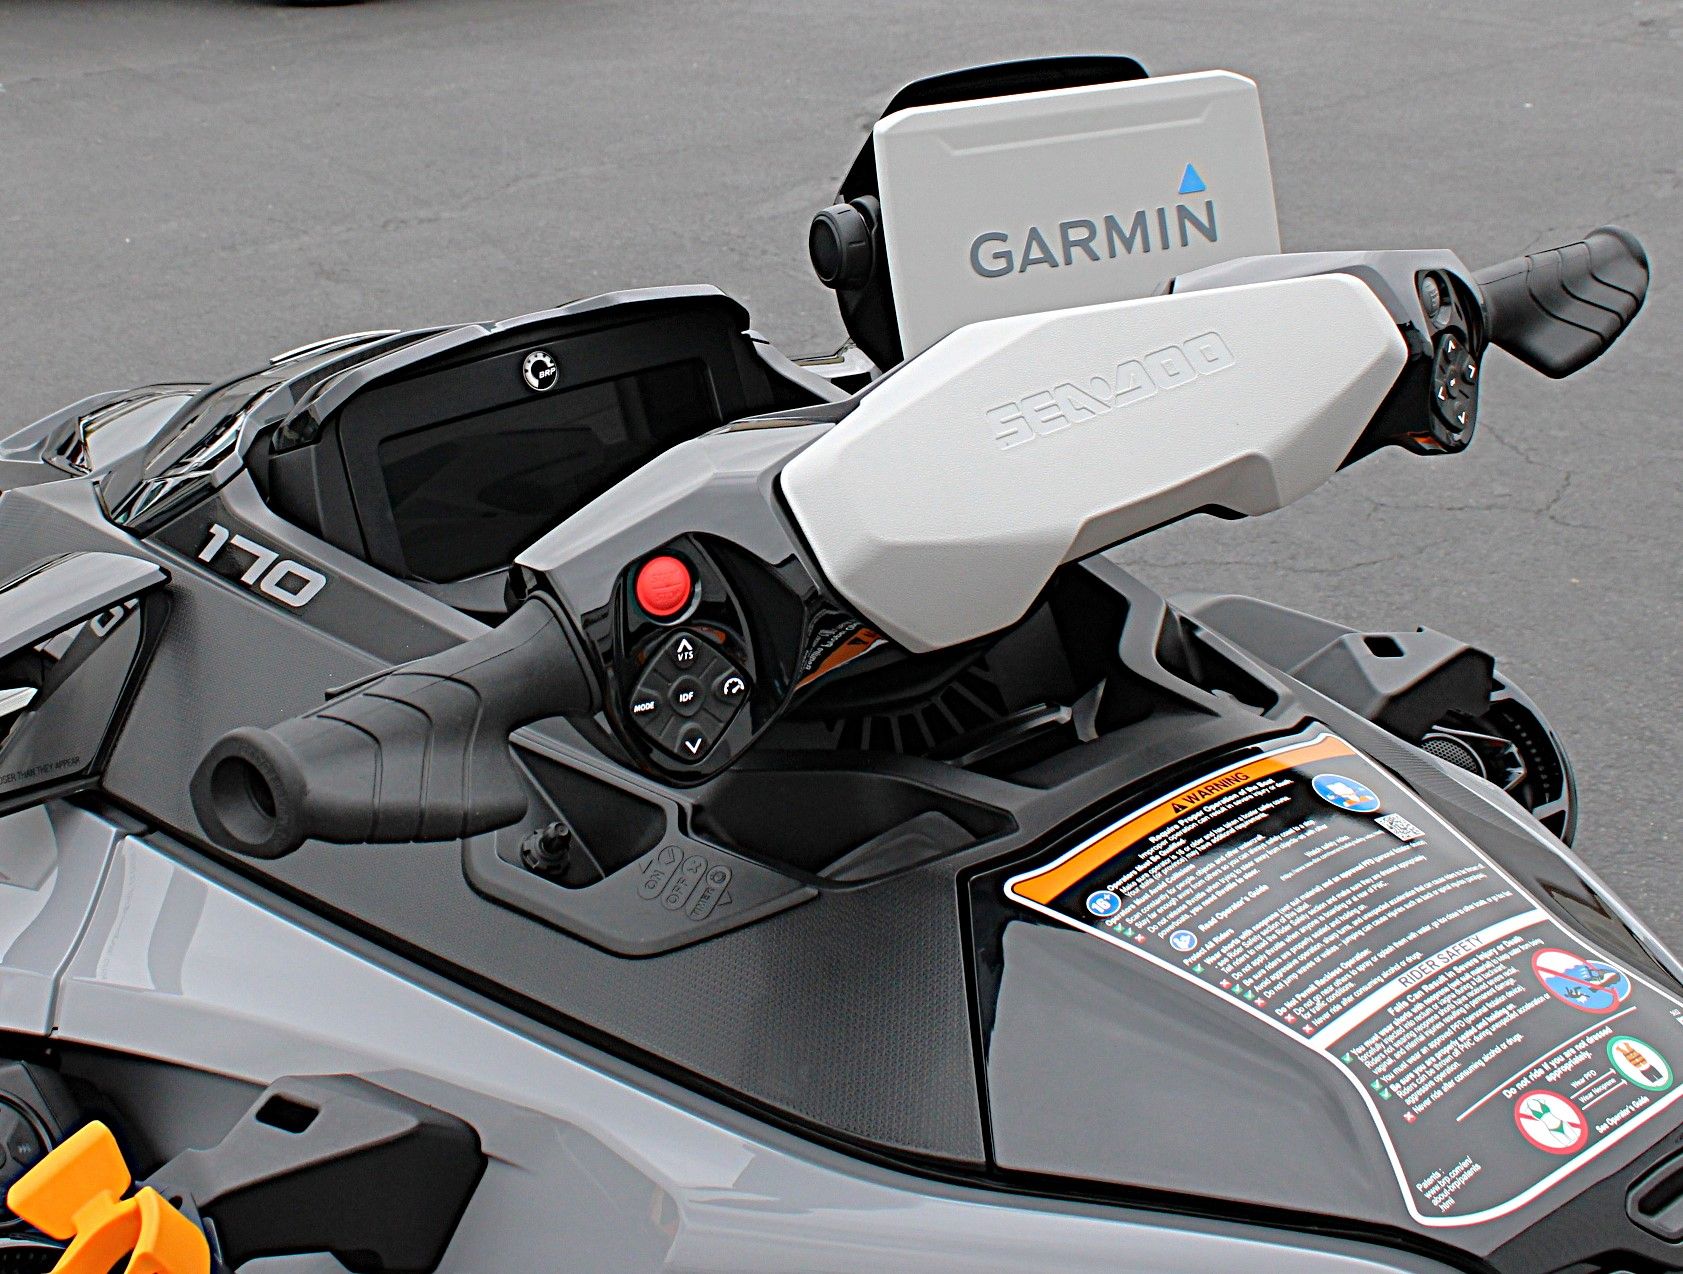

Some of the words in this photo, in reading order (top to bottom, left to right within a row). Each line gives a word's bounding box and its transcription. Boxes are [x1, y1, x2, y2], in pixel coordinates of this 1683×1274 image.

[970, 200, 1217, 278] GARMIN
[539, 367, 556, 379] BRP
[198, 523, 327, 607] 170
[678, 651, 694, 662] VTS
[633, 701, 655, 713] MODE
[679, 691, 694, 703] IDF
[17, 768, 35, 780] THAN
[36, 763, 54, 775] THEY
[54, 756, 80, 769] APPEAR
[1182, 772, 1250, 805] WARNING
[1148, 824, 1182, 843] Require
[1177, 810, 1206, 826] Proper
[1201, 794, 1239, 812] Operation
[1255, 778, 1276, 787] Boat
[644, 868, 665, 890] ON
[666, 877, 687, 905] OFF
[1104, 905, 1135, 927] Operators
[1133, 893, 1151, 906] Must
[1148, 881, 1168, 895] Avoid
[1164, 864, 1196, 884] Collisions
[1106, 870, 1138, 891] Operators
[1134, 859, 1152, 872] Must
[689, 886, 716, 917] TIMER
[1156, 914, 1191, 938] powerboats,
[1189, 905, 1203, 915] you
[1201, 894, 1218, 906] need
[1214, 882, 1238, 897] throttle
[1243, 869, 1261, 880] steer.
[1198, 917, 1217, 931] Read
[1214, 897, 1251, 920] Operator's
[1248, 885, 1269, 898] Guide
[1183, 947, 1207, 965] Protect
[1205, 941, 1215, 950] All
[1213, 929, 1234, 944] Riders
[1232, 972, 1242, 980] Do
[1242, 964, 1252, 973] not
[1251, 954, 1268, 966] apply
[1264, 941, 1285, 955] throttle
[1284, 931, 1300, 942] when
[1298, 919, 1320, 933] anyone
[1322, 902, 1349, 917] boarding
[1371, 881, 1389, 890] PWC.
[1242, 978, 1253, 986] Be
[1252, 969, 1265, 979] sure
[1264, 958, 1281, 970] riders
[1289, 937, 1314, 954] properly
[1311, 924, 1331, 938] seated
[1329, 918, 1342, 928] and
[1338, 909, 1362, 921] holding
[1387, 1001, 1409, 1015] Falls
[1406, 990, 1425, 1003] Can
[1421, 974, 1448, 993] Result
[1452, 958, 1480, 973] Severe
[1475, 948, 1501, 960] Injury
[1501, 935, 1524, 947] Death
[1397, 960, 1440, 987] RIDER
[1436, 935, 1485, 964] SAFETY
[1275, 1008, 1286, 1016] Do
[1284, 998, 1298, 1008] Not
[1295, 984, 1317, 1000] Permit
[1314, 968, 1343, 986] Reckless
[1302, 1012, 1312, 1020] for
[1310, 1002, 1327, 1013] traffic
[1327, 983, 1356, 1003] conditions.
[1312, 1013, 1331, 1026] Never
[1331, 1005, 1342, 1014] ride
[1341, 996, 1354, 1006] after
[1353, 977, 1384, 997] consuming
[1381, 964, 1402, 978] alcohol
[1405, 953, 1424, 963] drugs.
[1380, 1072, 1395, 1084] You
[1393, 1060, 1409, 1075] must
[1407, 1052, 1422, 1065] wear
[1421, 1046, 1430, 1054] an
[1428, 1028, 1454, 1049] approved
[1450, 1020, 1466, 1032] PFD
[1462, 1005, 1489, 1025] (personal
[1485, 995, 1508, 1009] flotation
[1504, 985, 1526, 998] device).
[1389, 1082, 1402, 1092] Be
[1400, 1072, 1416, 1085] sure
[1413, 1064, 1427, 1076] you
[1425, 1056, 1437, 1066] are
[1434, 1040, 1462, 1061] properly
[1457, 1026, 1478, 1043] seated
[1476, 1018, 1489, 1030] and
[1484, 1007, 1510, 1023] holding
[1505, 1003, 1517, 1011] on.
[1396, 1082, 1418, 1098] Riders
[1415, 1074, 1428, 1084] can
[1424, 1068, 1436, 1077] be
[1432, 1055, 1454, 1071] thrown
[1452, 1048, 1462, 1058] off
[1458, 1039, 1476, 1052] PWC
[1472, 1029, 1494, 1042] during
[1490, 1011, 1520, 1032] unexpected
[1517, 996, 1546, 1015] acceleration
[1405, 1080, 1436, 1105] aggressive
[1434, 1062, 1462, 1083] operation.
[1412, 1098, 1432, 1114] Never
[1430, 1090, 1444, 1101] ride
[1441, 1080, 1456, 1092] after
[1454, 1060, 1486, 1083] consuming
[1482, 1046, 1503, 1062] alcohol
[1504, 1034, 1524, 1046] drugs.
[1502, 1087, 1518, 1098] Do
[1516, 1076, 1531, 1090] not
[1528, 1068, 1545, 1081] ride
[1549, 1055, 1566, 1068] you
[1562, 1048, 1577, 1058] are
[1574, 1040, 1589, 1051] not
[1584, 1026, 1613, 1044] dressed
[1545, 1052, 1592, 1082] appropriately.
[1570, 1078, 1586, 1088] Wear
[1583, 1069, 1598, 1080] PFD
[1578, 1092, 1595, 1103] Wear
[1591, 1078, 1617, 1094] Neoprene
[1595, 1124, 1610, 1133] See
[1606, 1106, 1636, 1126] Operator's
[1631, 1096, 1650, 1109] Guide
[1416, 1171, 1442, 1193] Patents
[1424, 1156, 1475, 1199] www.brp.com/en/
[1432, 1163, 1482, 1206] about-brp/patents
